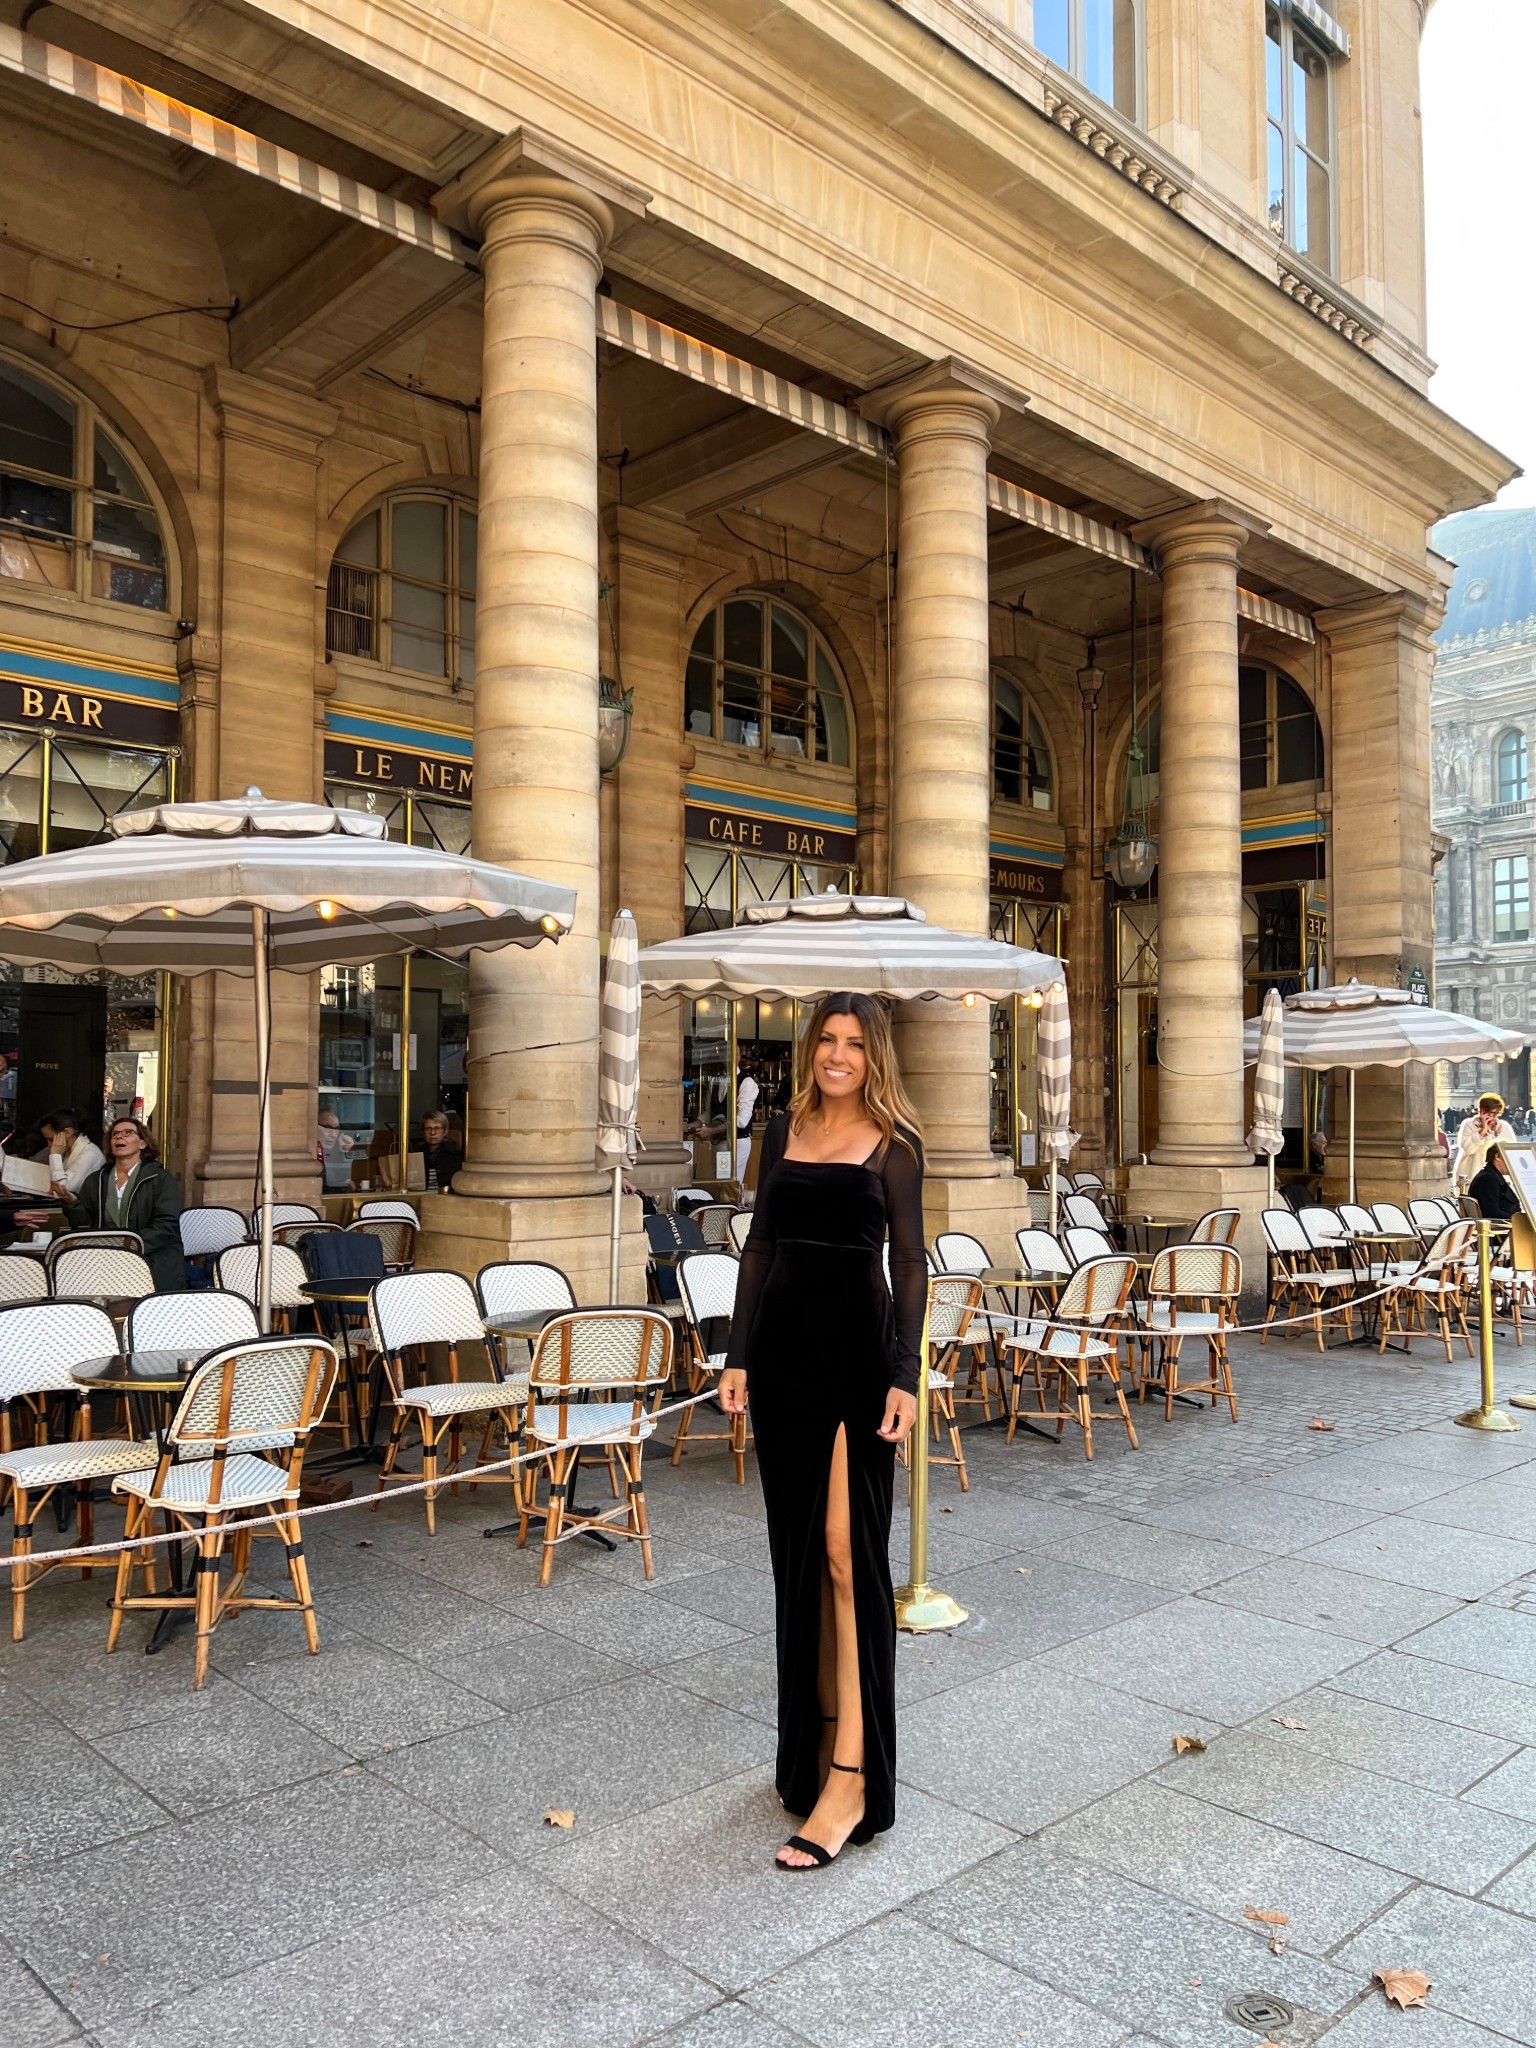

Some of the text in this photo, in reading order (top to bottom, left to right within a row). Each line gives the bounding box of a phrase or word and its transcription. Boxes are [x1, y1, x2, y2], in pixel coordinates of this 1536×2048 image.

[21, 686, 104, 730] BAR
[355, 749, 394, 780] LE
[709, 817, 825, 857] CAFE BAR
[1411, 983, 1426, 993] PLACE
